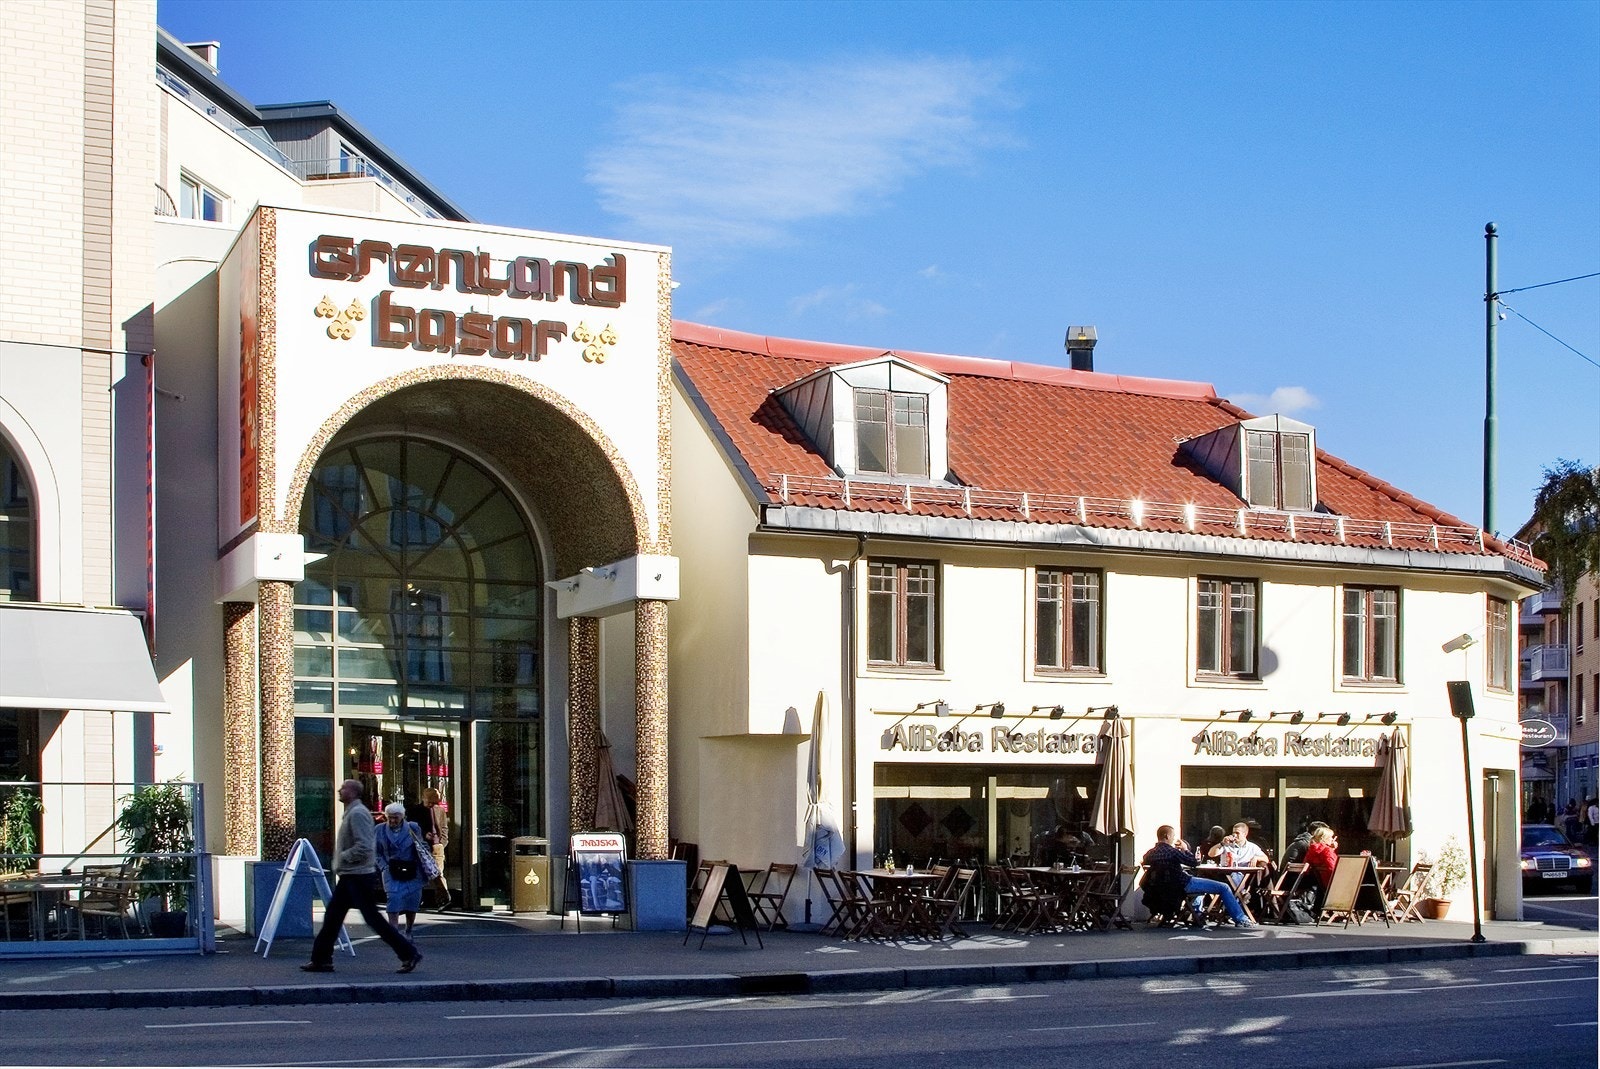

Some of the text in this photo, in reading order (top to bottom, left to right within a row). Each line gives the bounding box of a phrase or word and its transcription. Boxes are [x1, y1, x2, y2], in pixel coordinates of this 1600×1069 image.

[889, 723, 985, 752] AliBaba
[1194, 729, 1279, 757] AliBaba
[579, 839, 619, 847] INDISKA
